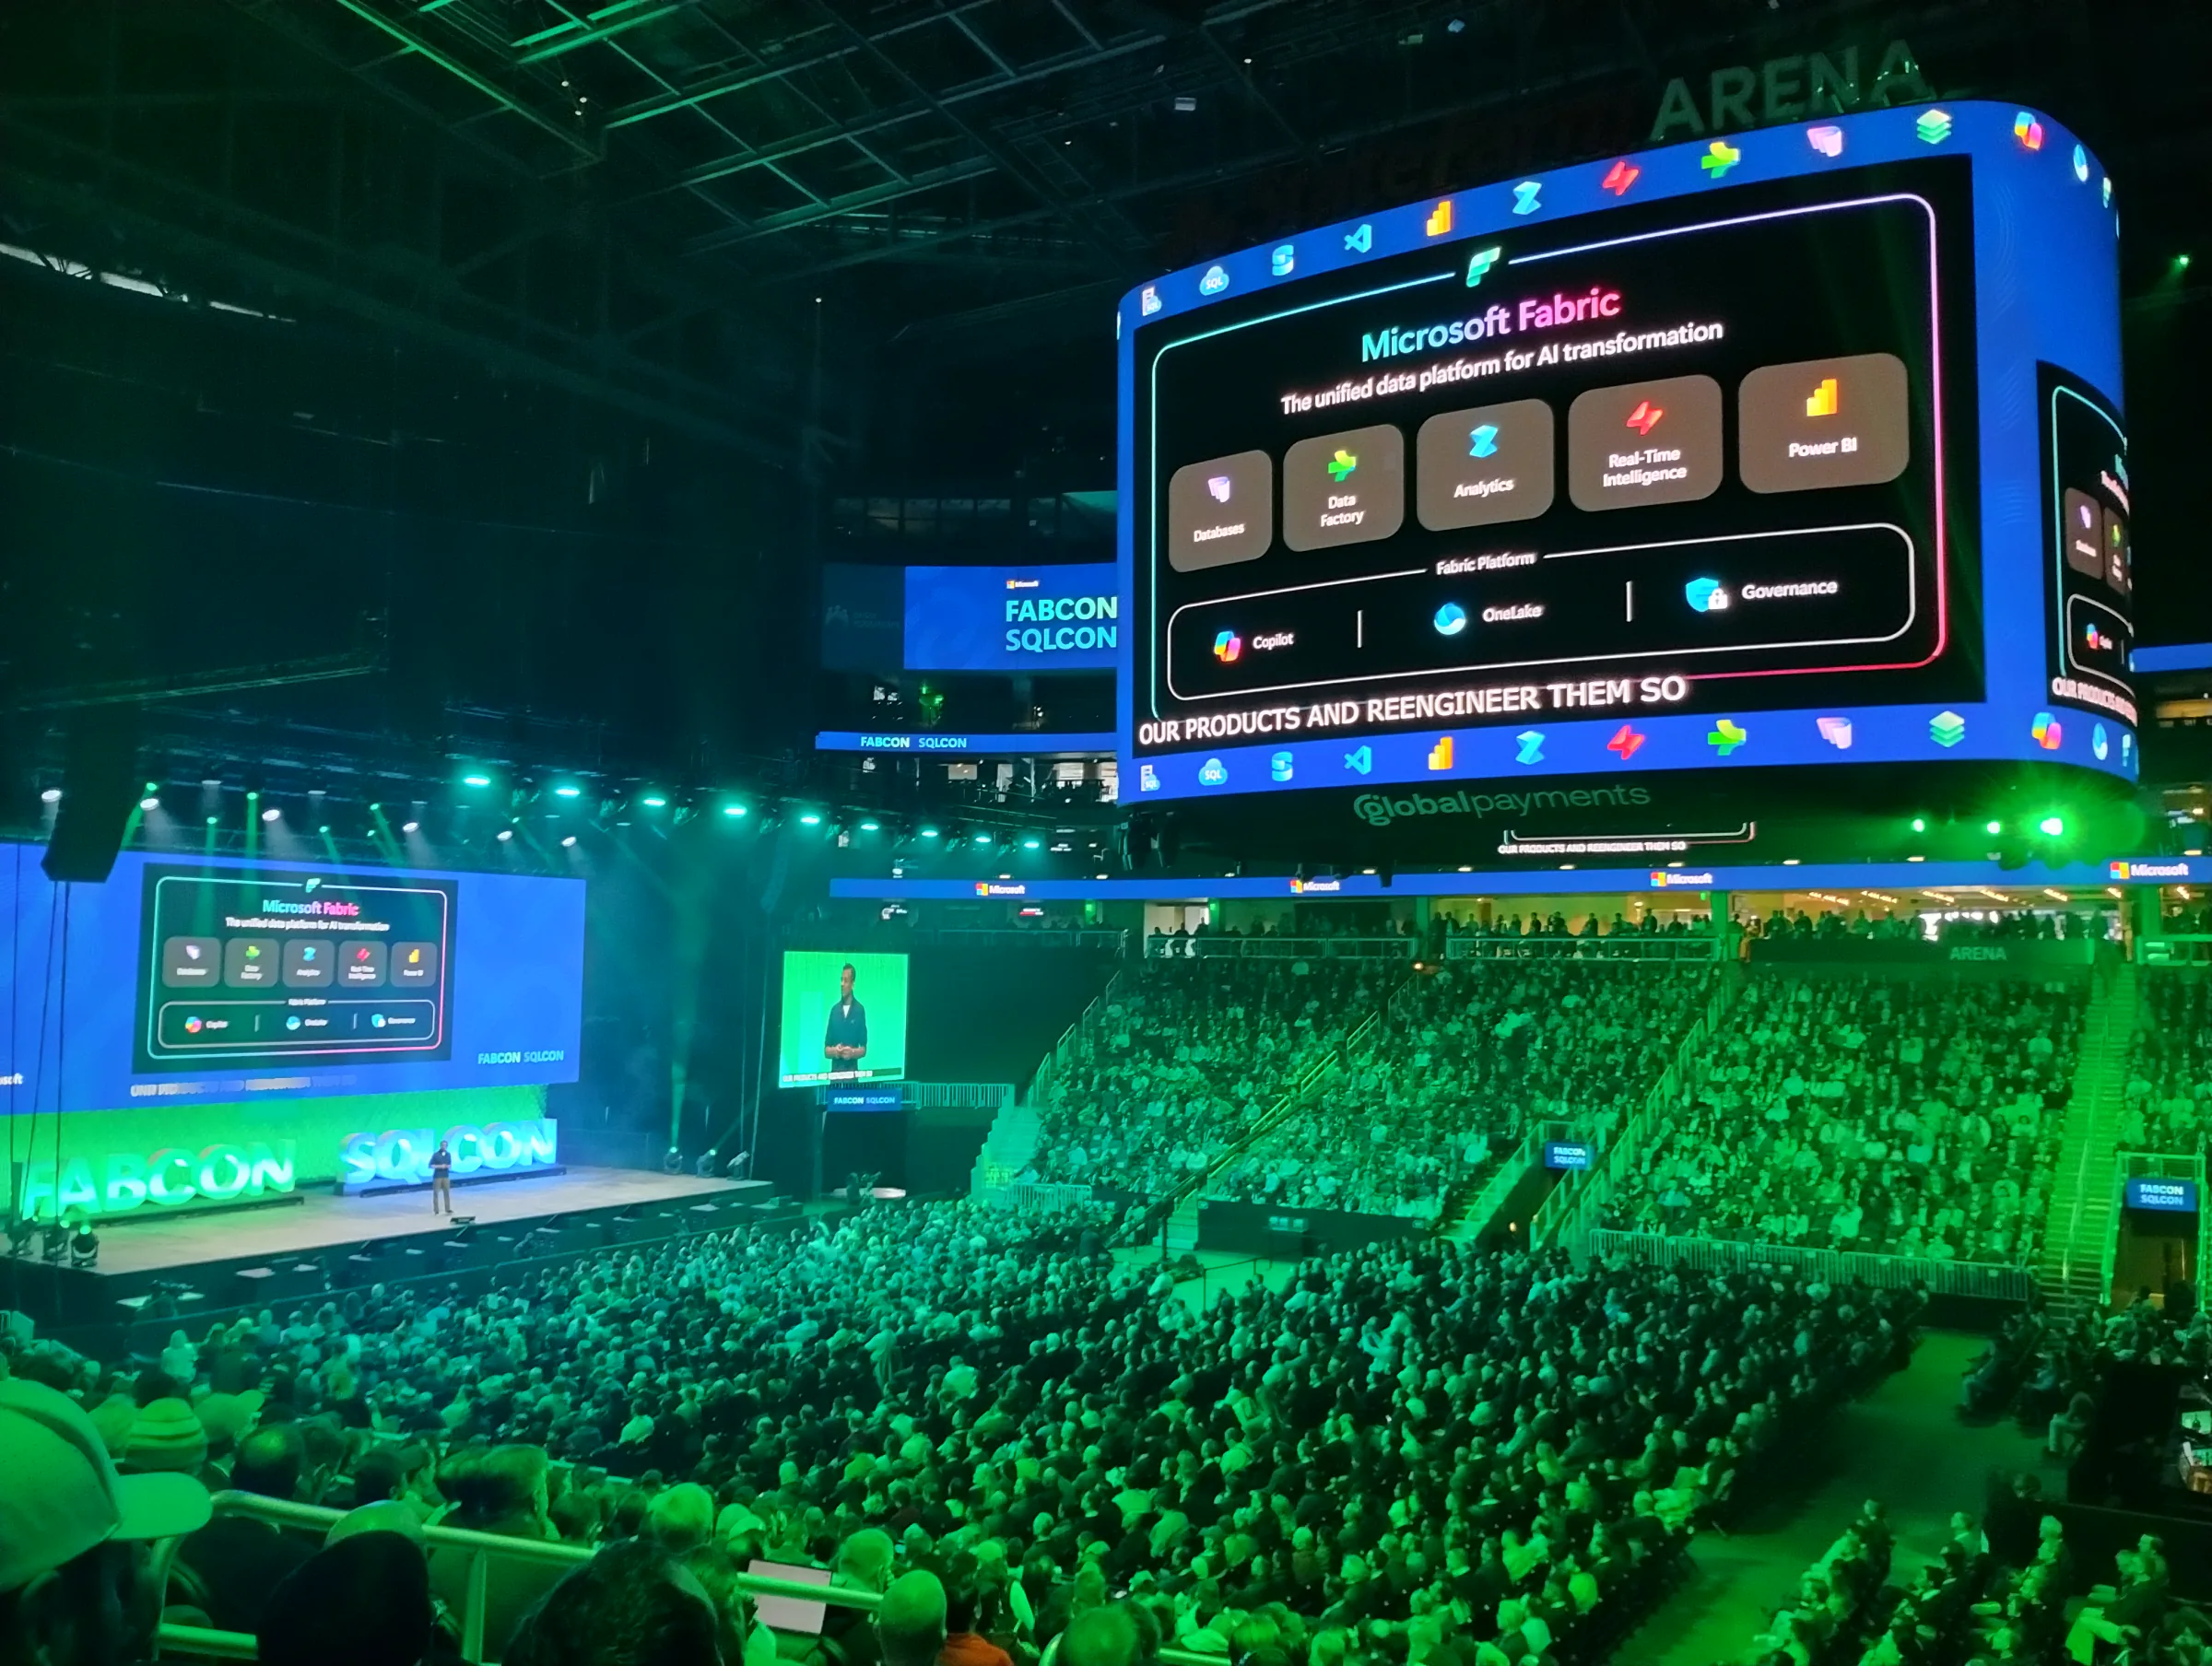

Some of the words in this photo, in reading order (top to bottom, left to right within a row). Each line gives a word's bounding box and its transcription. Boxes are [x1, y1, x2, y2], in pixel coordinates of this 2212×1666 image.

[1649, 40, 1935, 141] ARENA
[1206, 276, 1224, 290] SQL
[1361, 305, 1511, 362] Microsoft
[1519, 287, 1621, 331] Fabric
[1281, 393, 1312, 415] The
[1315, 377, 1372, 408] unified
[1376, 372, 1417, 396] data
[1420, 358, 1500, 392] platform
[1505, 350, 1535, 370] for
[1536, 344, 1559, 367] AI
[1563, 323, 1724, 361] transformation
[1789, 442, 1838, 458] Power
[1841, 438, 1857, 452] BI
[1608, 448, 1681, 468] Real-Time
[1603, 465, 1688, 487] Intelligence
[1453, 477, 1514, 499] Analytics
[1328, 494, 1357, 510] Data
[1321, 510, 1365, 527] Factory
[1194, 522, 1245, 542] Databases
[1435, 557, 1476, 576] Fabric
[1477, 552, 1536, 570] Platform
[1741, 581, 1839, 600] Governance
[1006, 597, 1117, 622] FABCON
[1482, 604, 1545, 622] OneLake
[1006, 627, 1117, 653] SQLCON
[1253, 632, 1295, 651] Copilot
[1139, 719, 1180, 745] OUR
[1185, 707, 1300, 739] PRODUCTS
[1307, 701, 1359, 728] AND
[1368, 686, 1541, 722] REENGINEER
[1547, 679, 1631, 709] THEM
[1641, 675, 1687, 702] SO
[861, 737, 910, 748] FABCON
[918, 738, 967, 749] SQLCON
[1205, 769, 1222, 782] SQL
[1355, 783, 1652, 827] globalpayments
[1498, 844, 1518, 854] OUR
[1671, 840, 1687, 851] SO
[2130, 862, 2189, 876] Microsoft
[1303, 880, 1340, 892] Microsoft
[1666, 873, 1712, 885] Microsoft
[989, 885, 1025, 896] Microsoft
[263, 899, 322, 914] Microsoft
[323, 901, 359, 916] Fabric
[1949, 946, 2007, 961] ARENA
[477, 1051, 521, 1064] FABCON
[524, 1050, 564, 1063] SQLCON
[834, 1097, 864, 1105] FABCON
[865, 1097, 895, 1105] SQLCON
[21, 1139, 297, 1221] FABCON
[2140, 1184, 2183, 1195] FABCON
[2140, 1194, 2184, 1205] SQLCON
